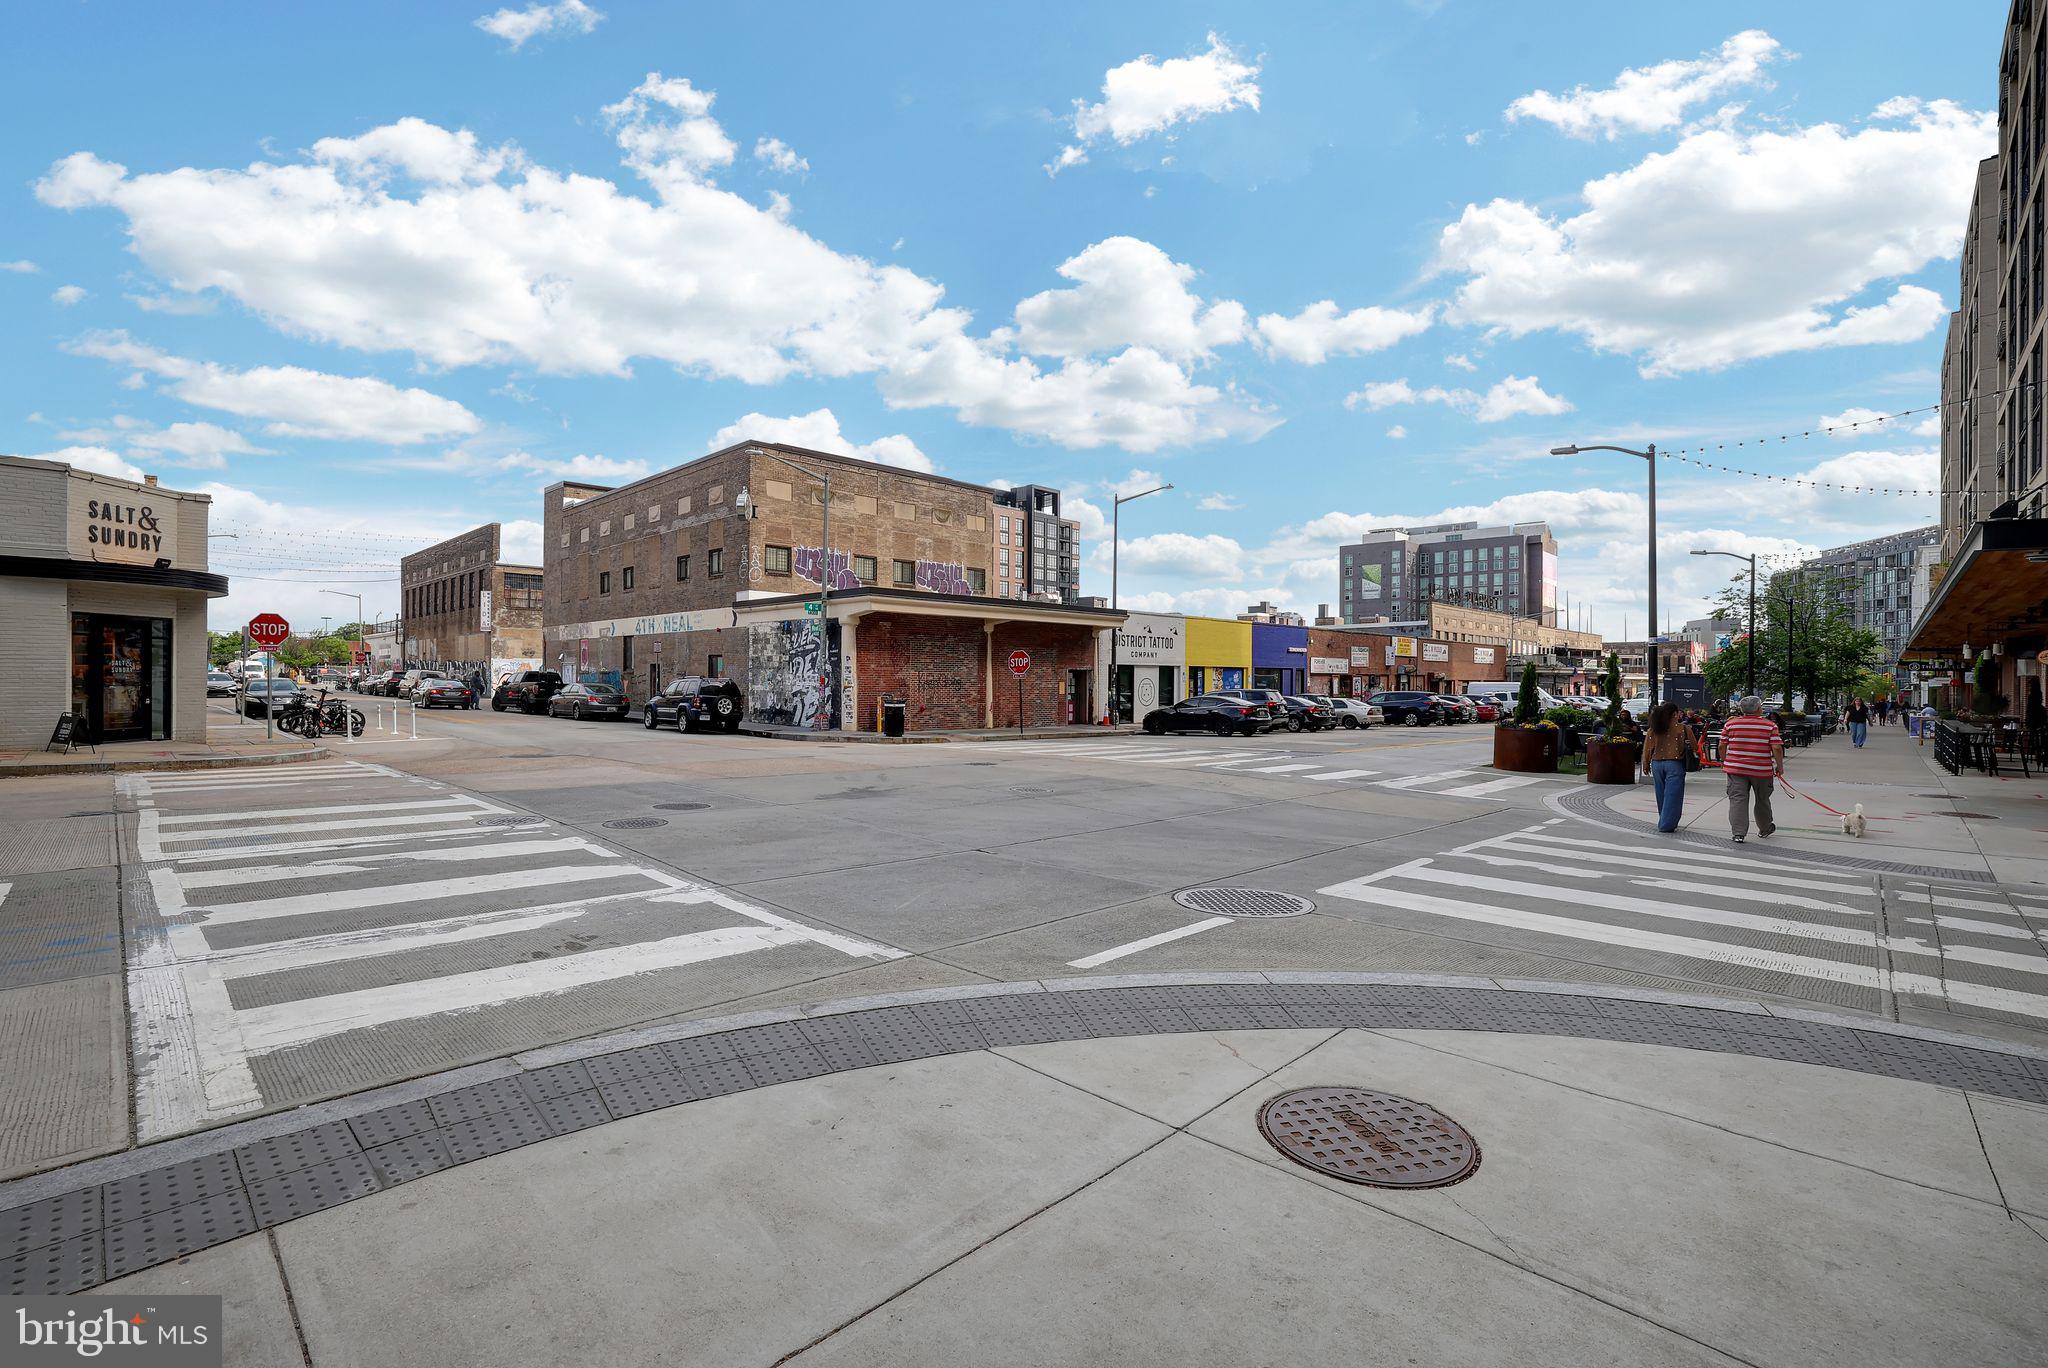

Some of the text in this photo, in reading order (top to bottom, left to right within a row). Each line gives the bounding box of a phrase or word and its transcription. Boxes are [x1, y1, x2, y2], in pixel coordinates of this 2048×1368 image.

[88, 525, 162, 552] SUNDRY
[252, 623, 287, 636] STOP
[635, 618, 655, 634] 4TH
[663, 614, 694, 632] NEAL
[1148, 636, 1174, 649] TATTOO
[1010, 658, 1028, 668] STOP
